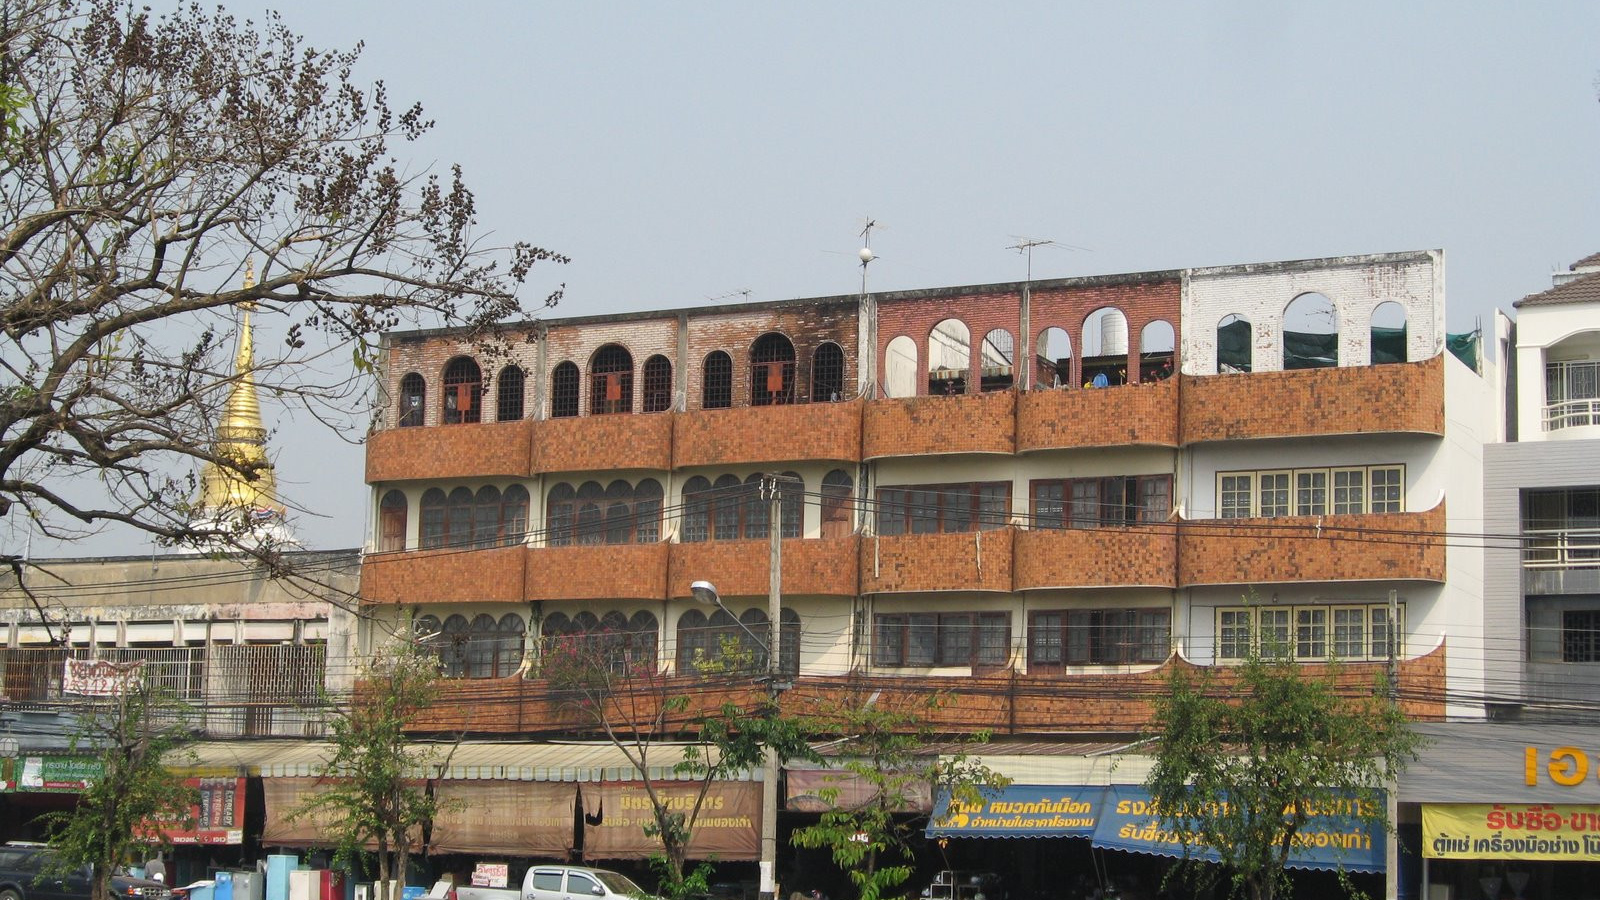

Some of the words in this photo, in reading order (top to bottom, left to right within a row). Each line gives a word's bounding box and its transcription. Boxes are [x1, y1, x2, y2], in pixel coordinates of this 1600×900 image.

[1525, 746, 1600, 786] เอ
[971, 814, 1095, 828] จำหน่ายในราคาโรงงาน
[1486, 803, 1600, 831] รับซื้อ-ขา
[1474, 831, 1580, 855] เครื่องมือช่าง
